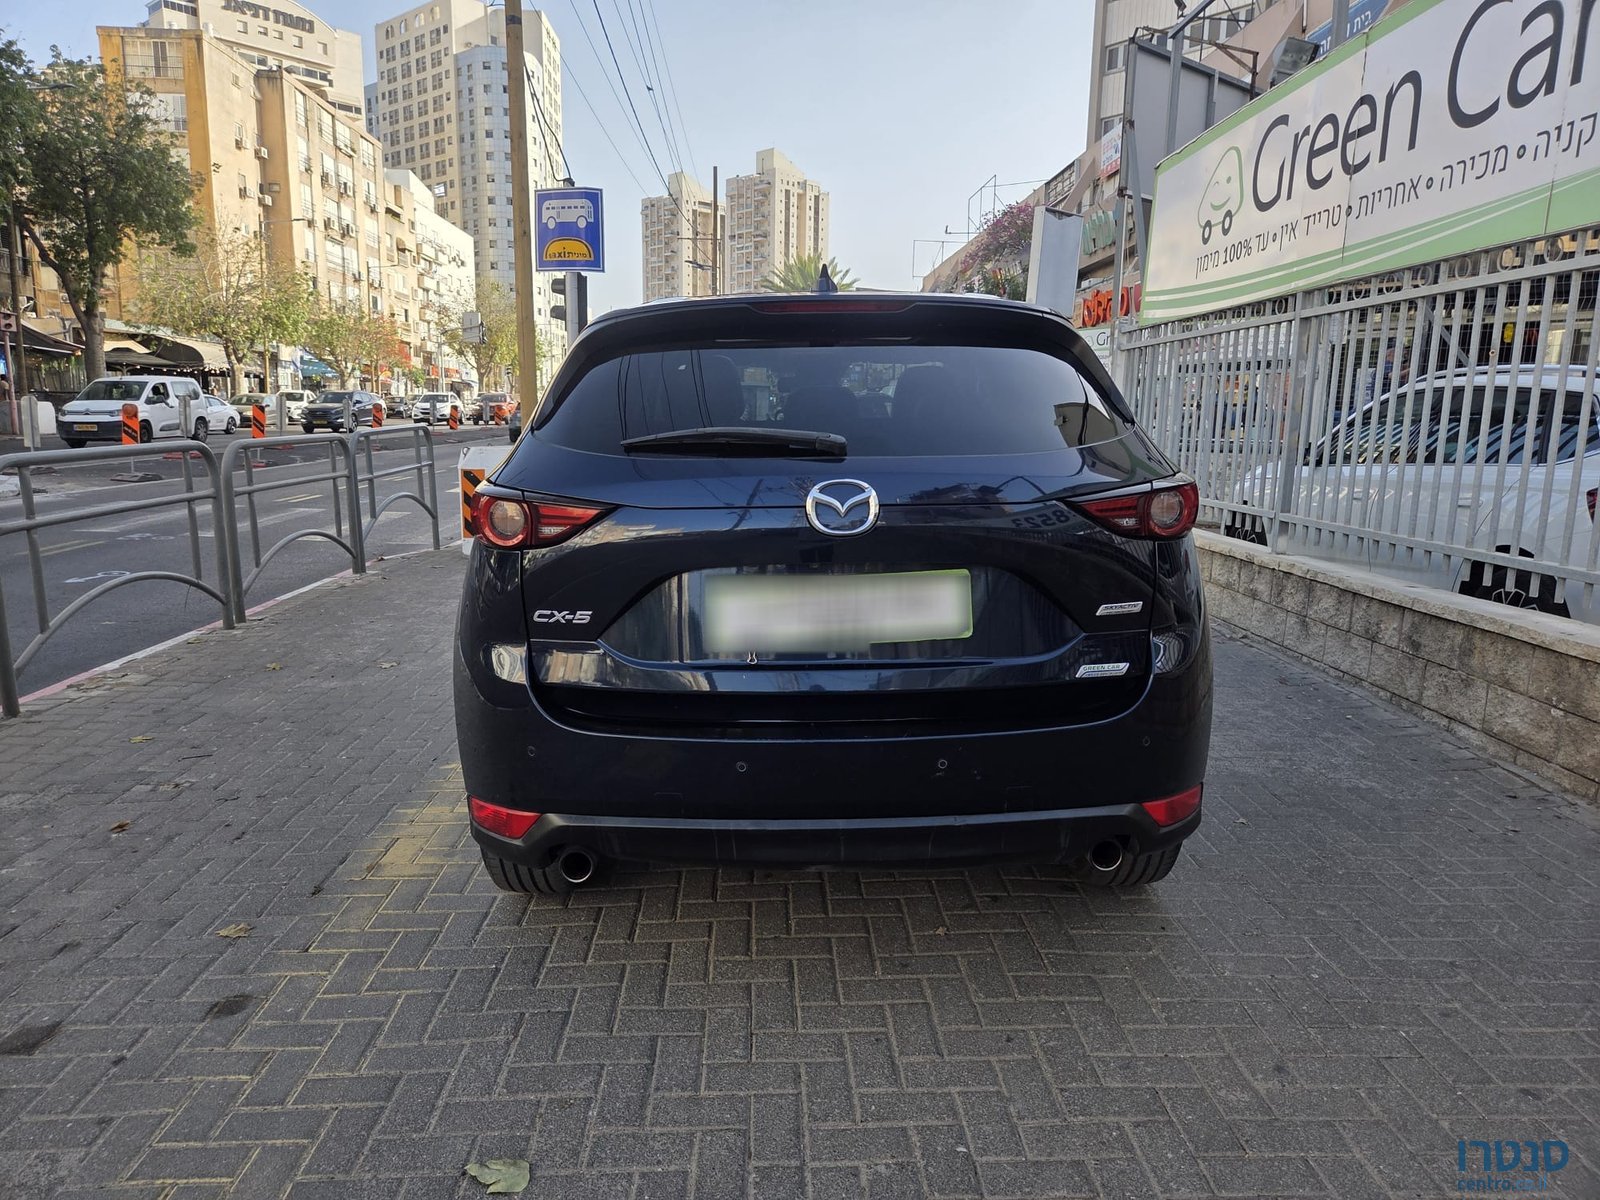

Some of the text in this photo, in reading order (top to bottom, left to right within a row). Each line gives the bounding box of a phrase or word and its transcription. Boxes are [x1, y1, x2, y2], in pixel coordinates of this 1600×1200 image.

[1252, 0, 1600, 213] Green Car
[1195, 112, 1599, 280] קניה מכירה אחריות טרייד אין עד 100% מימון
[533, 610, 593, 624] CX-5
